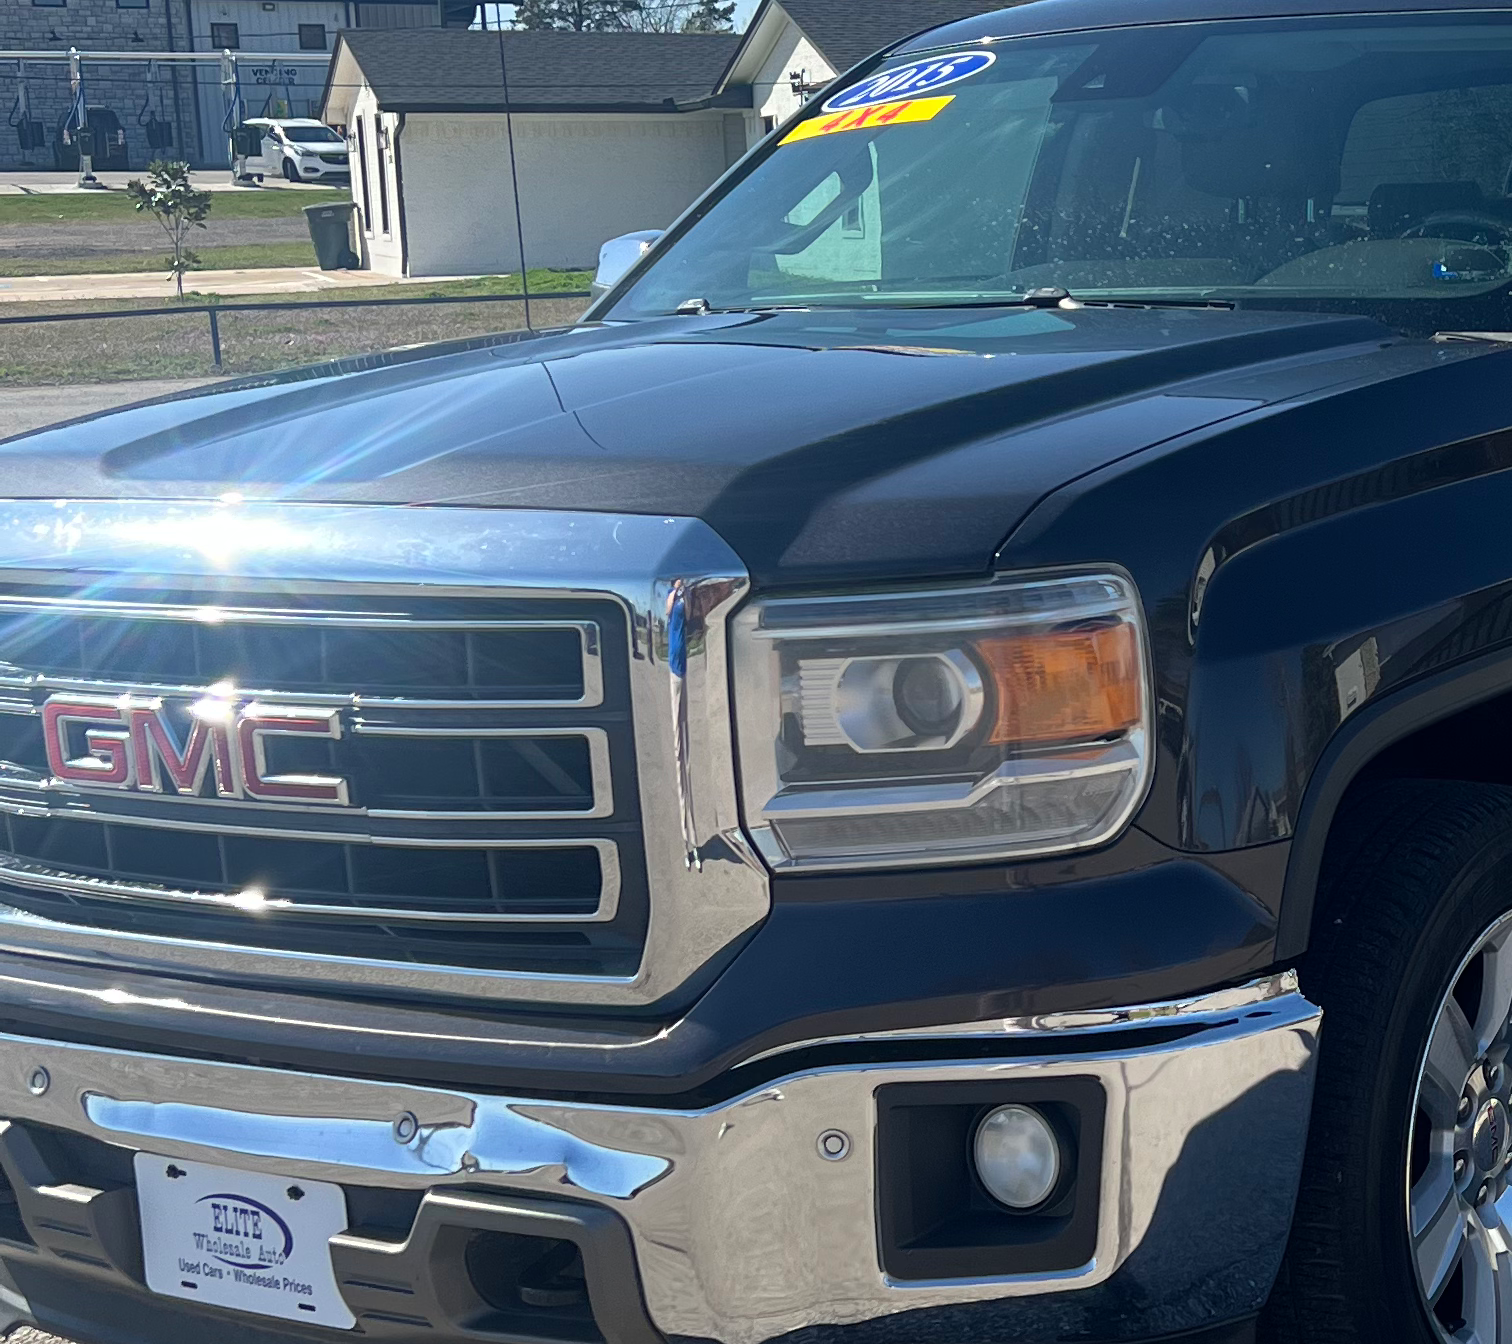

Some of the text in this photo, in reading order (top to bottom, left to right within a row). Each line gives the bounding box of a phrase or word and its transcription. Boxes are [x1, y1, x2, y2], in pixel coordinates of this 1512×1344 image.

[837, 56, 973, 108] 2015
[42, 693, 350, 806] GMC
[211, 1203, 263, 1240] ELITE
[193, 1232, 286, 1266] Wholesale Auto
[178, 1257, 313, 1296] Used Cars Wholesale Prices
